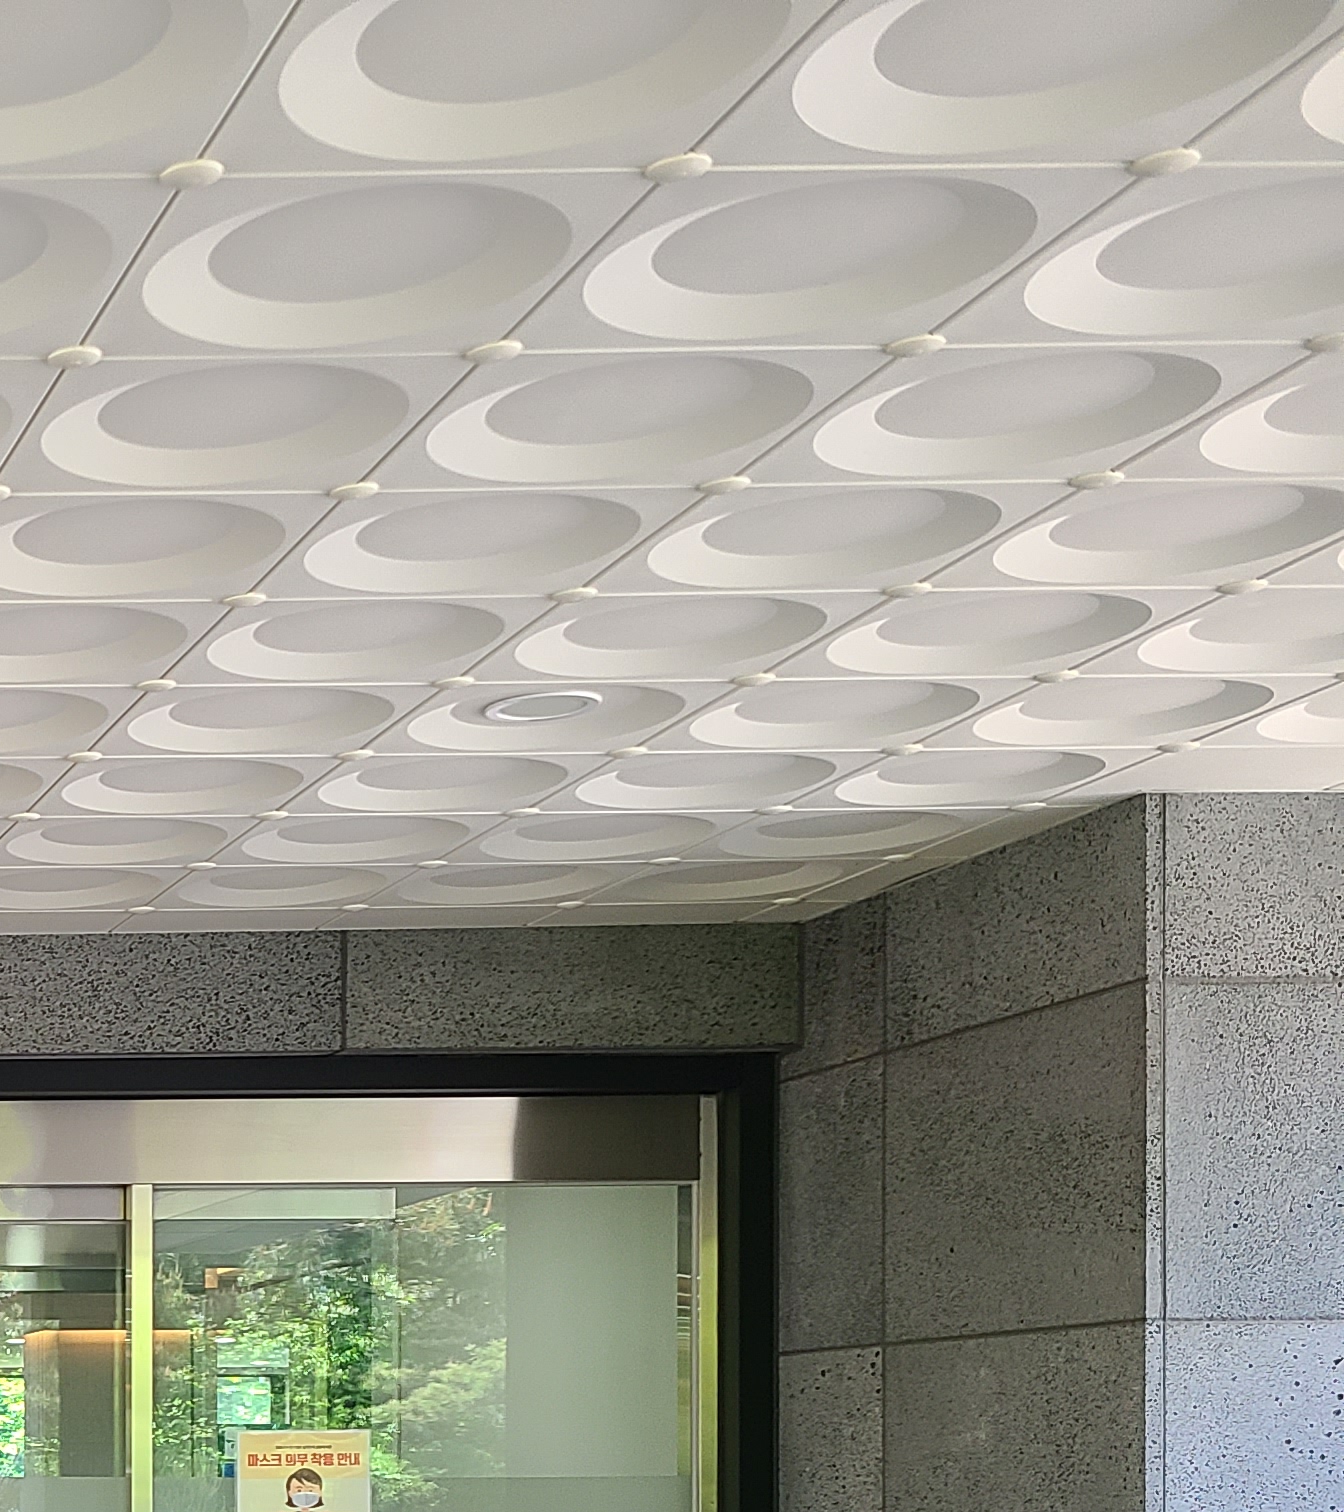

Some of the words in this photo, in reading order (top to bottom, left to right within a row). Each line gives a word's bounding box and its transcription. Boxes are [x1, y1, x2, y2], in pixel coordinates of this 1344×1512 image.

[247, 1453, 283, 1467] 마스크
[285, 1453, 309, 1467] 의무
[310, 1452, 335, 1467] 착용
[337, 1452, 361, 1466] 안내
